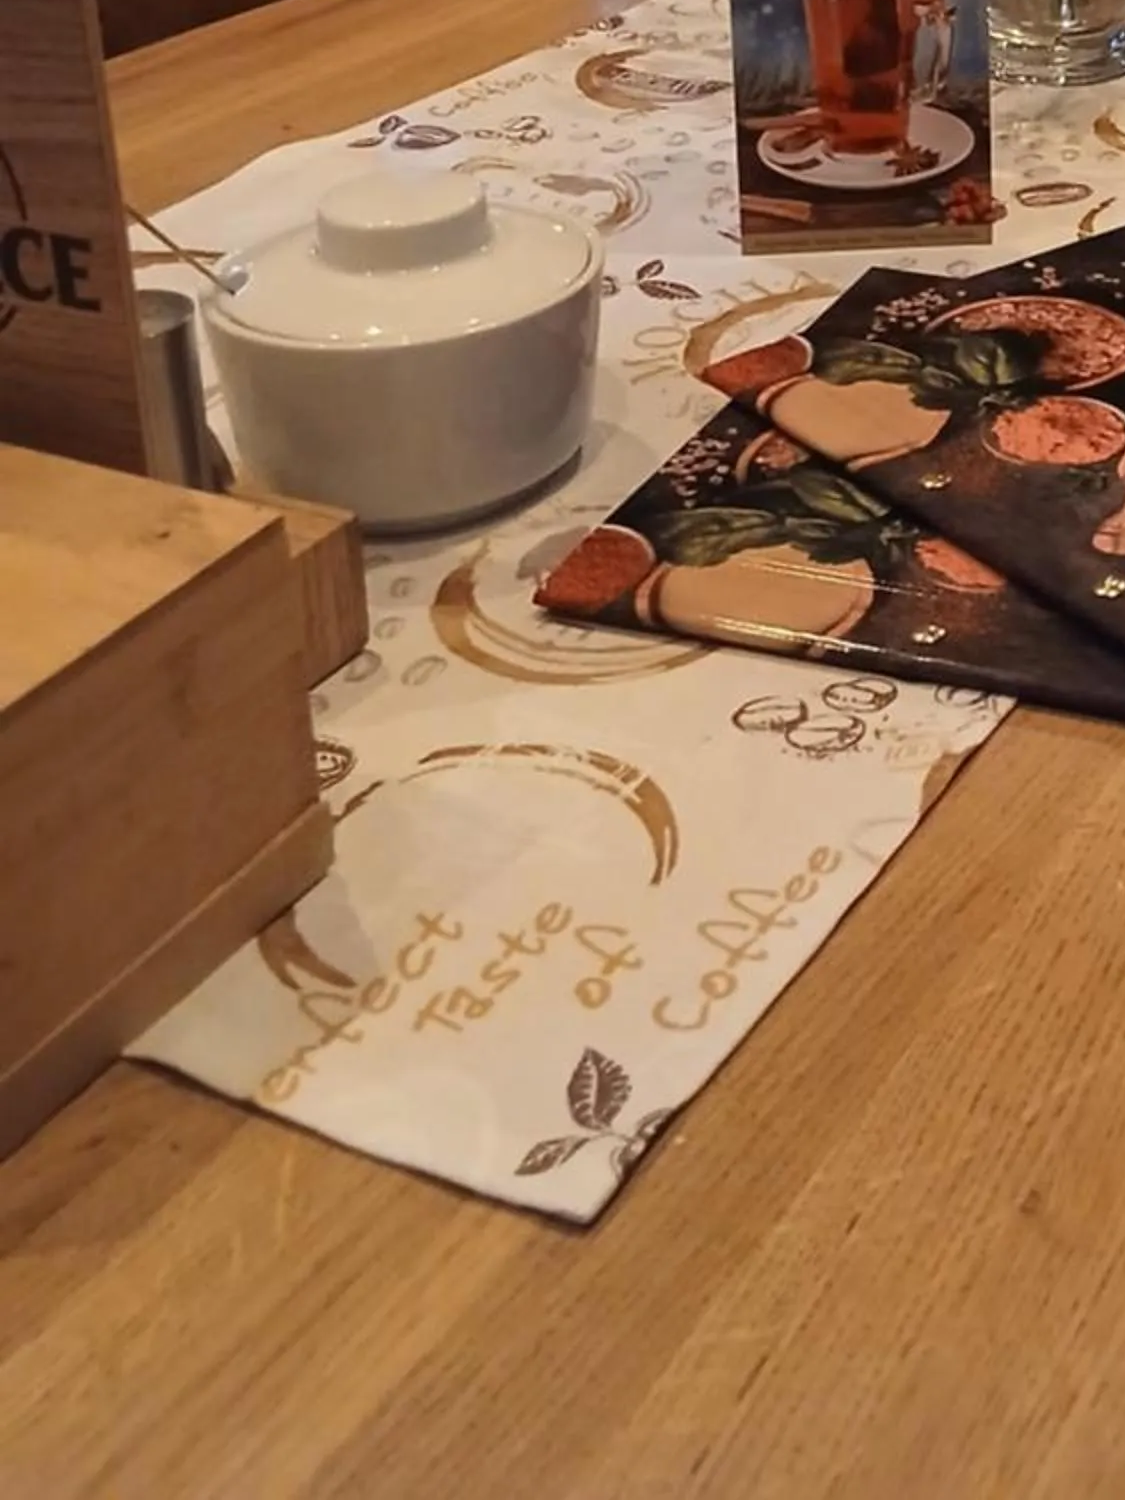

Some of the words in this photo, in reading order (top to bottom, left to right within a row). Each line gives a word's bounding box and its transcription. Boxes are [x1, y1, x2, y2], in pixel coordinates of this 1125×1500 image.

[0, 226, 103, 314] CE
[411, 902, 574, 1033] Taste
[573, 924, 644, 1010] of
[651, 845, 843, 1031] Coffee
[260, 911, 464, 1104] erfect
